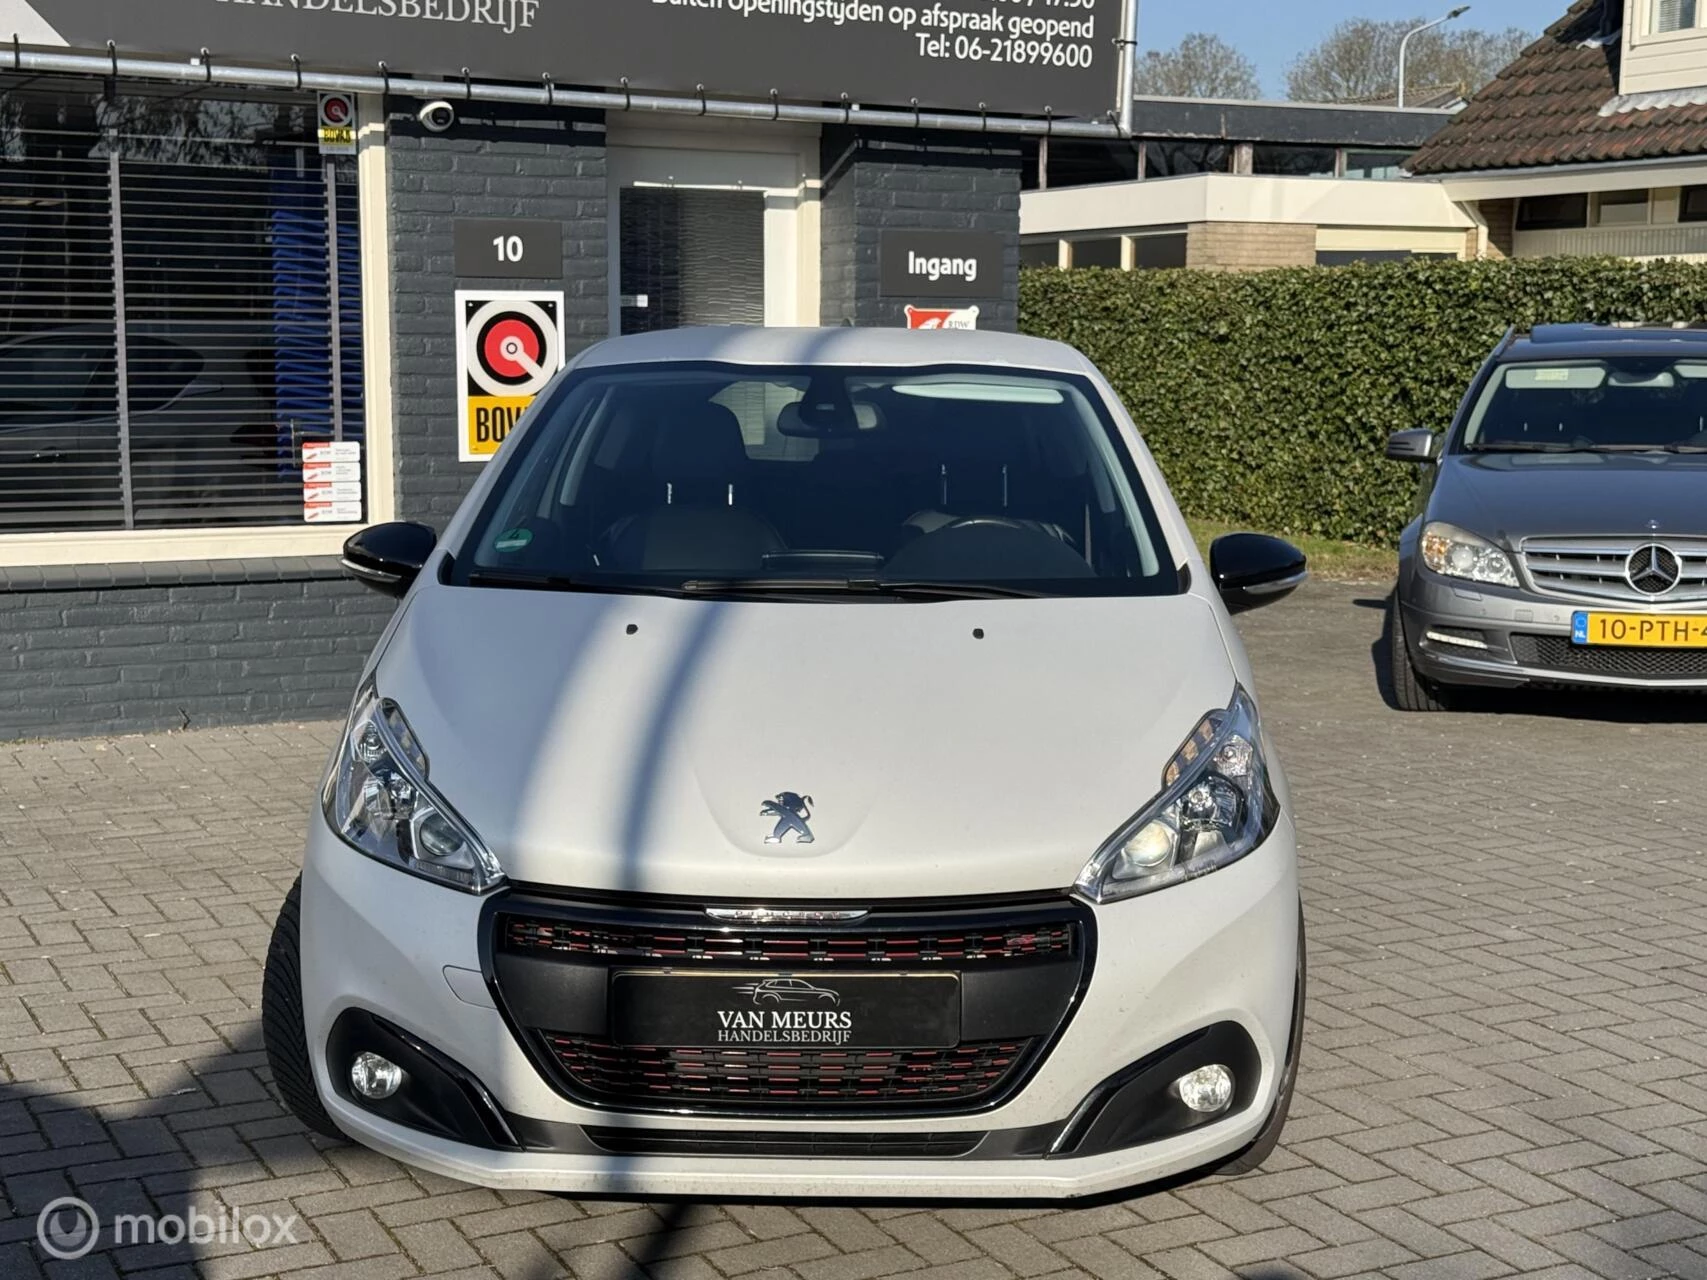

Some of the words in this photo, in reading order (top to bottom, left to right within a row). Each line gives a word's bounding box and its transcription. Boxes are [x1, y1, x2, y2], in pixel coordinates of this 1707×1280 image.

[888, 5, 916, 31] op
[921, 3, 1004, 33] afspraak
[1007, 15, 1095, 41] geopend
[915, 32, 951, 58] Tel:
[954, 35, 1093, 68] 06-21899600
[493, 235, 524, 262] 10
[908, 250, 977, 282] Ingang
[476, 406, 527, 443] BOV
[1574, 629, 1586, 639] NL
[717, 1010, 765, 1029] VAN
[771, 1010, 852, 1029] MEURS
[717, 1030, 852, 1046] HANDELSBEDRIJF
